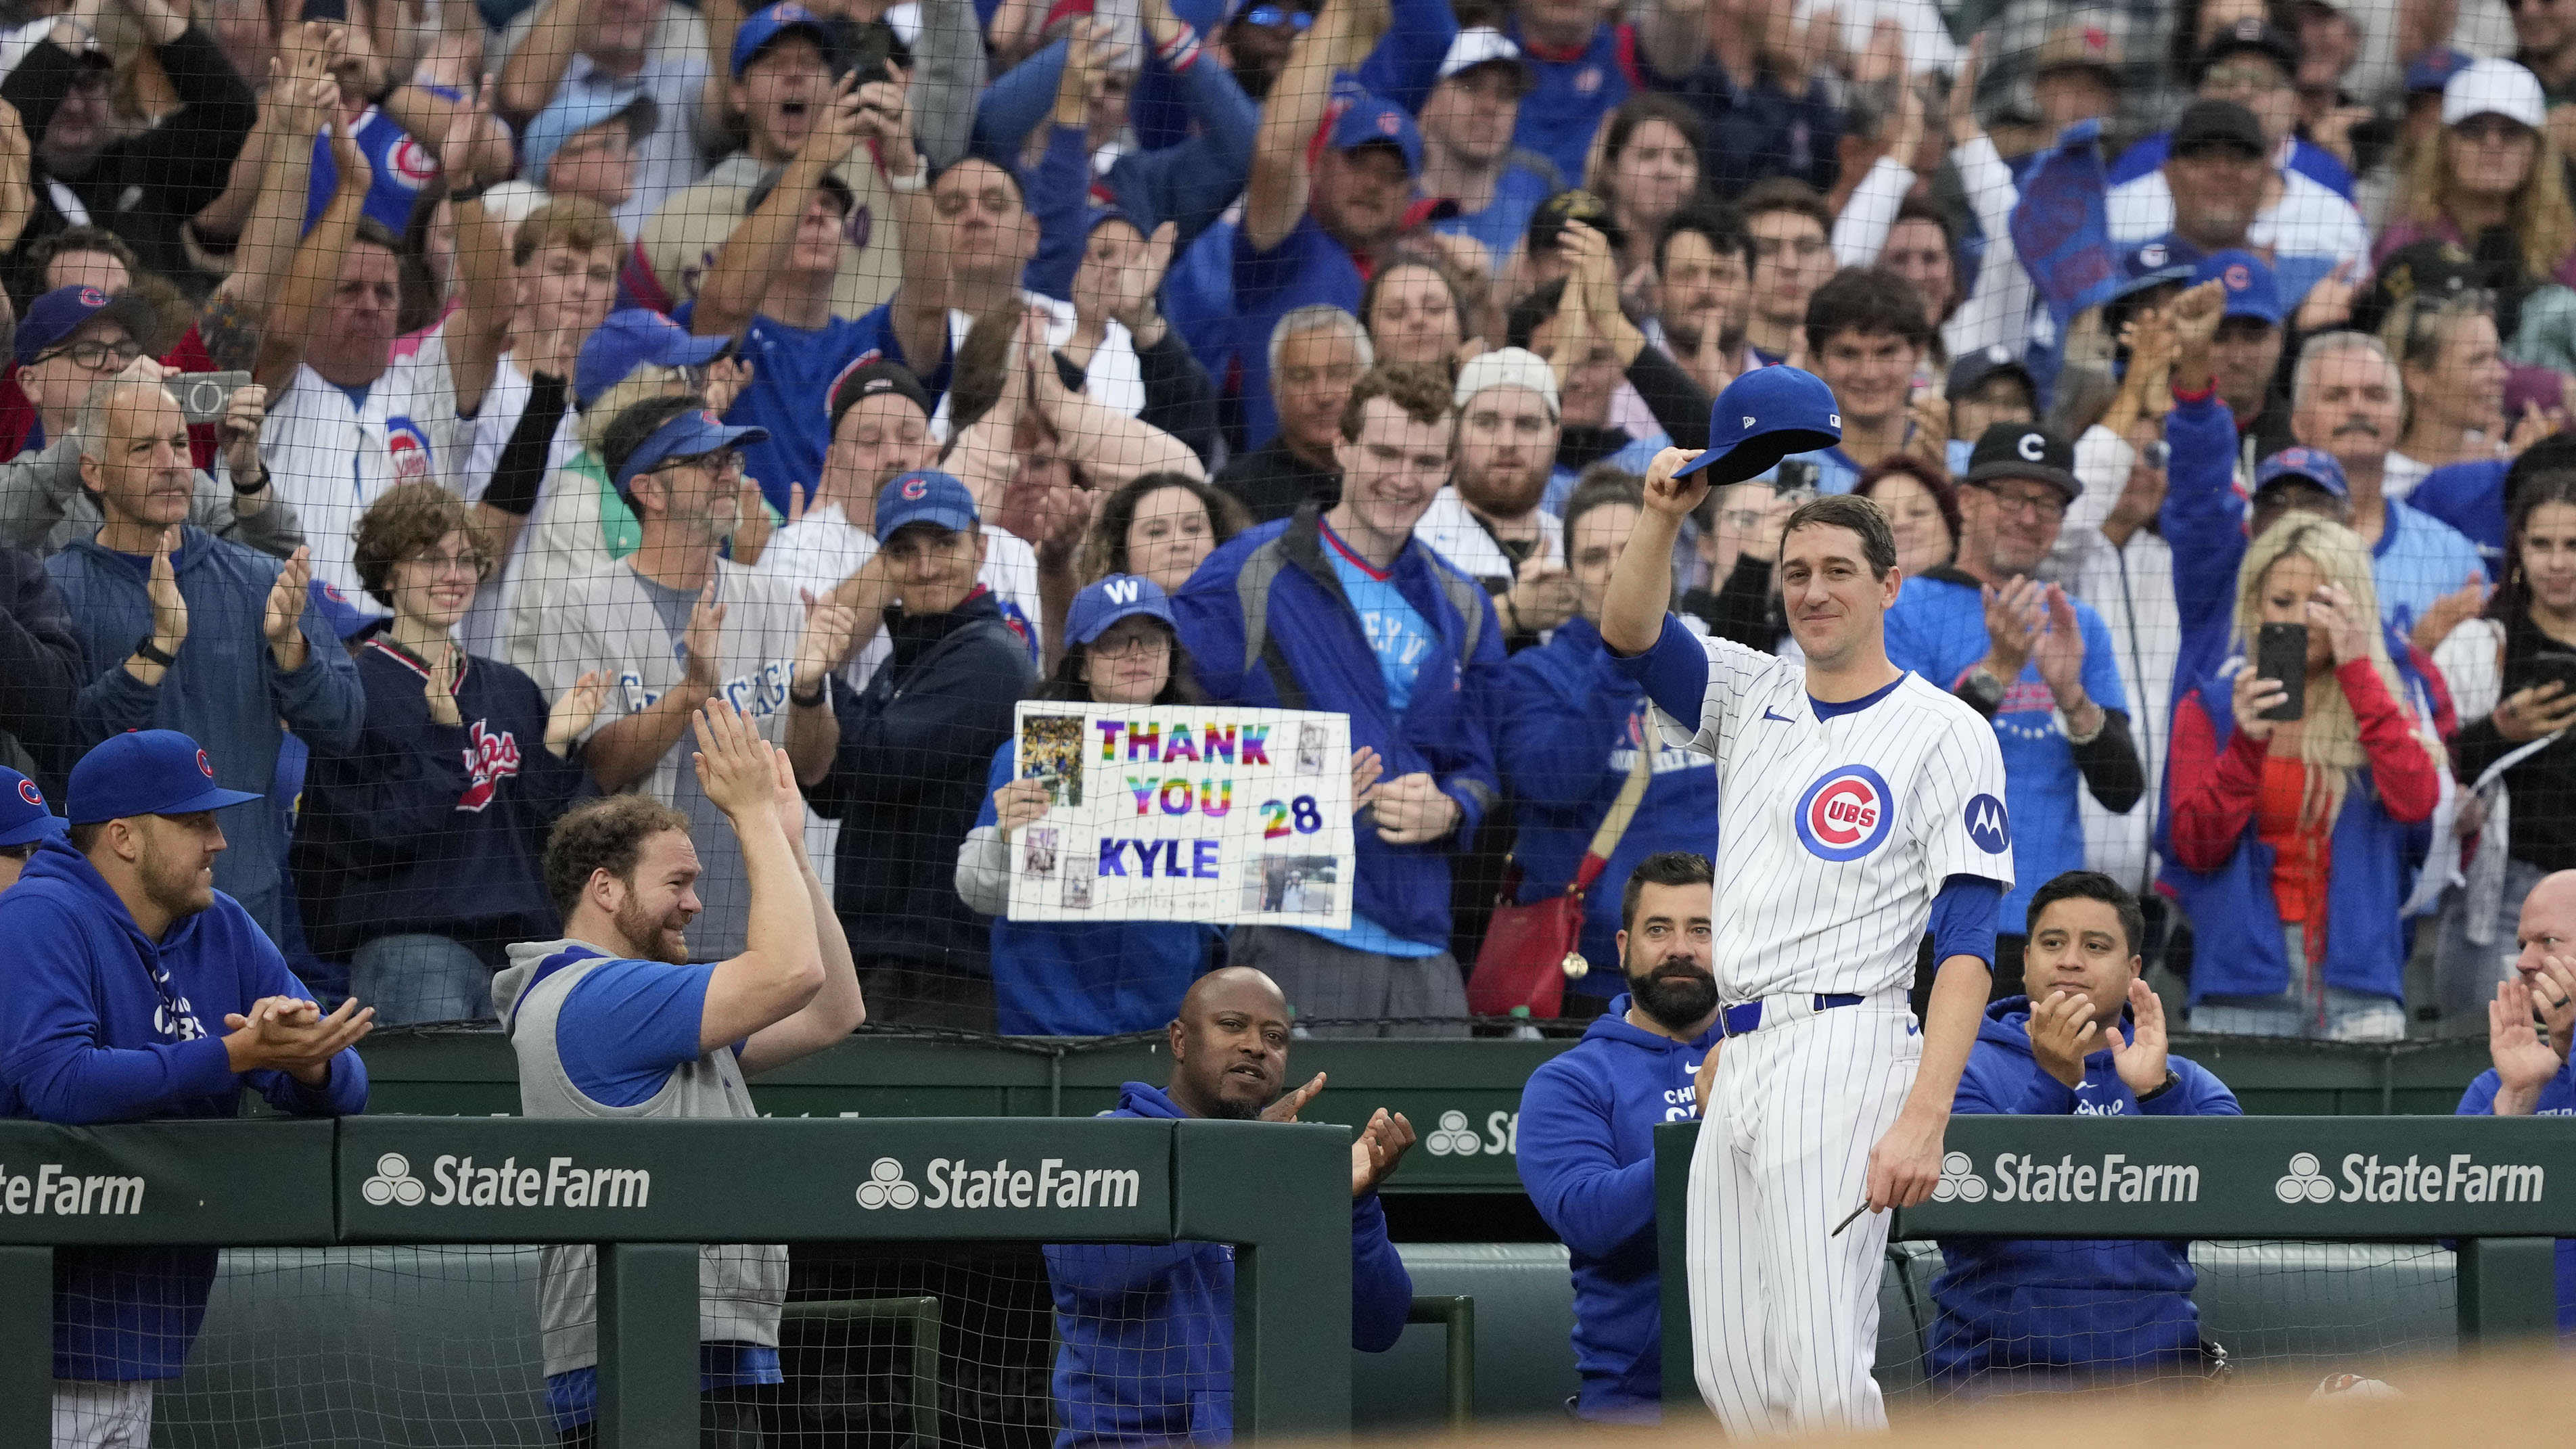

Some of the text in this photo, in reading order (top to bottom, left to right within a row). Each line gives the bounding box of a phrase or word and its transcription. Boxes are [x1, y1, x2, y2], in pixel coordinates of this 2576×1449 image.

[2018, 433, 2046, 461] C
[902, 478, 927, 501] C
[1103, 579, 1138, 605] W
[1096, 720, 1270, 766] THANK
[196, 748, 213, 778] C
[18, 779, 42, 805] C
[1126, 776, 1233, 817] YOU
[1260, 794, 1322, 840] 28
[1099, 837, 1220, 879] KYLE
